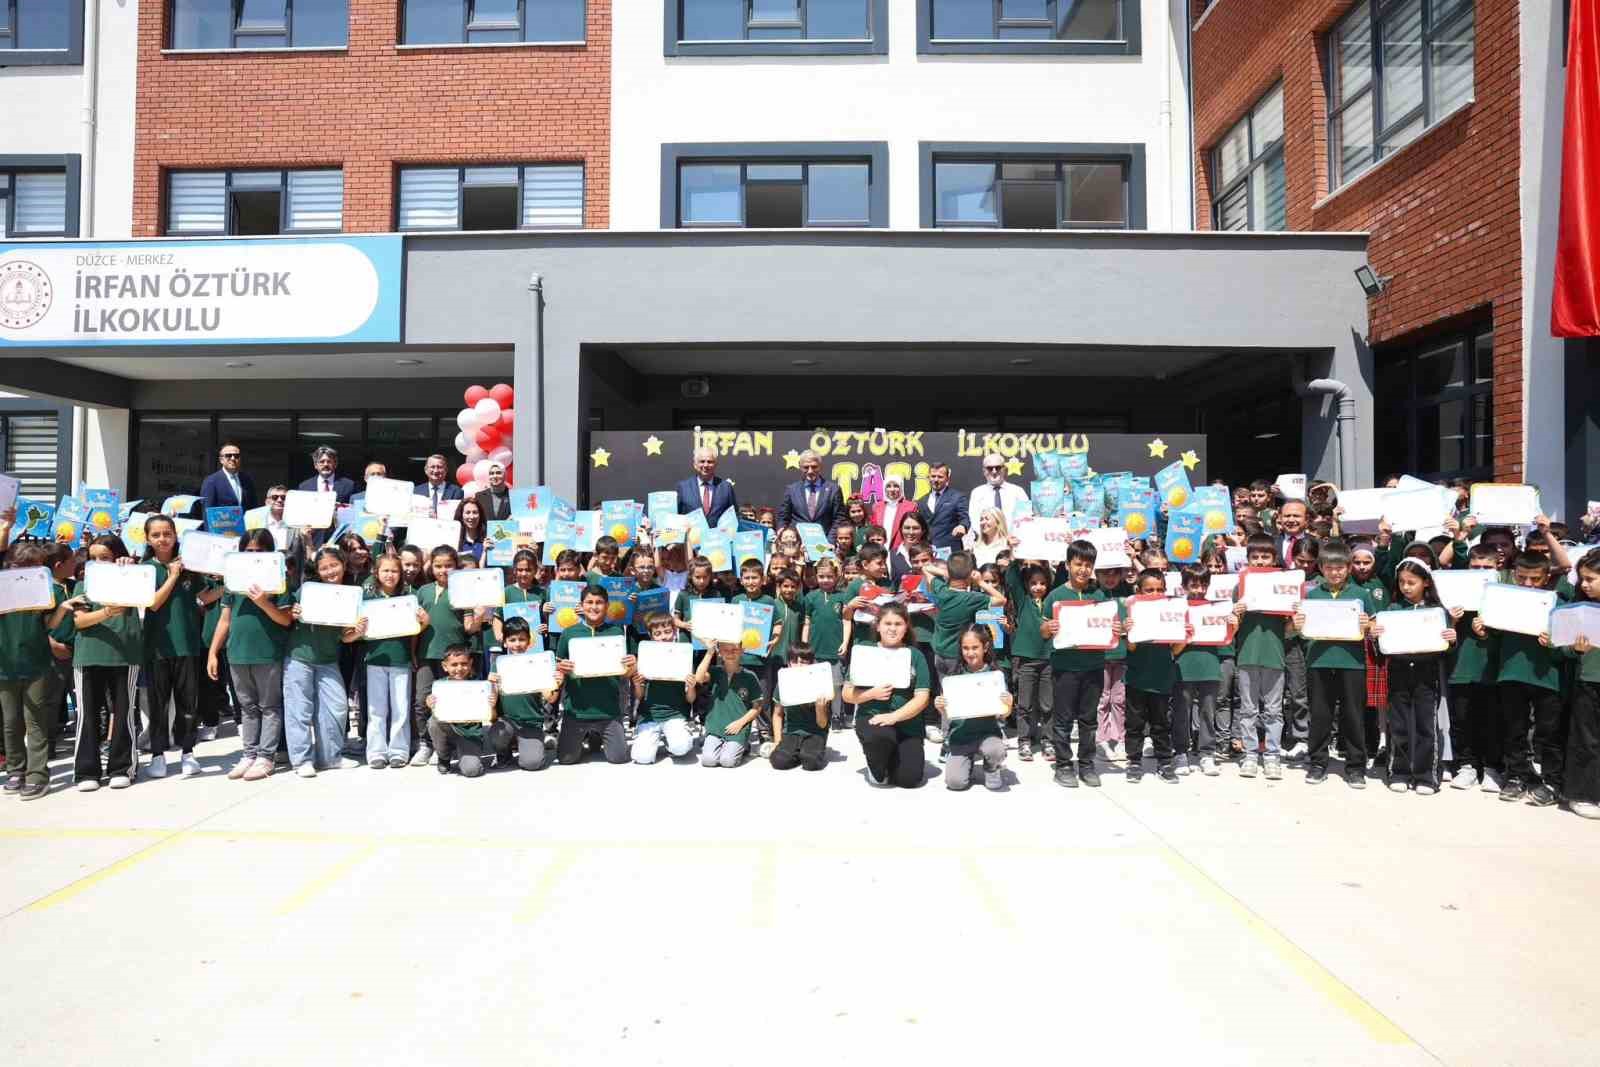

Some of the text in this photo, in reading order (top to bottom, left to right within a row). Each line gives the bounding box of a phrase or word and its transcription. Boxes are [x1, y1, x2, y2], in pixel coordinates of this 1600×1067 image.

[76, 254, 117, 267] DÜZCE
[126, 253, 174, 266] MERKEZ
[75, 270, 160, 299] İRFAN
[169, 268, 291, 297] ÖZTÜRK
[73, 304, 220, 334] İLKOKULU
[693, 426, 1090, 458] İRFAN ÖZTÜRK İLKOKULU
[831, 461, 951, 505] TATİ
